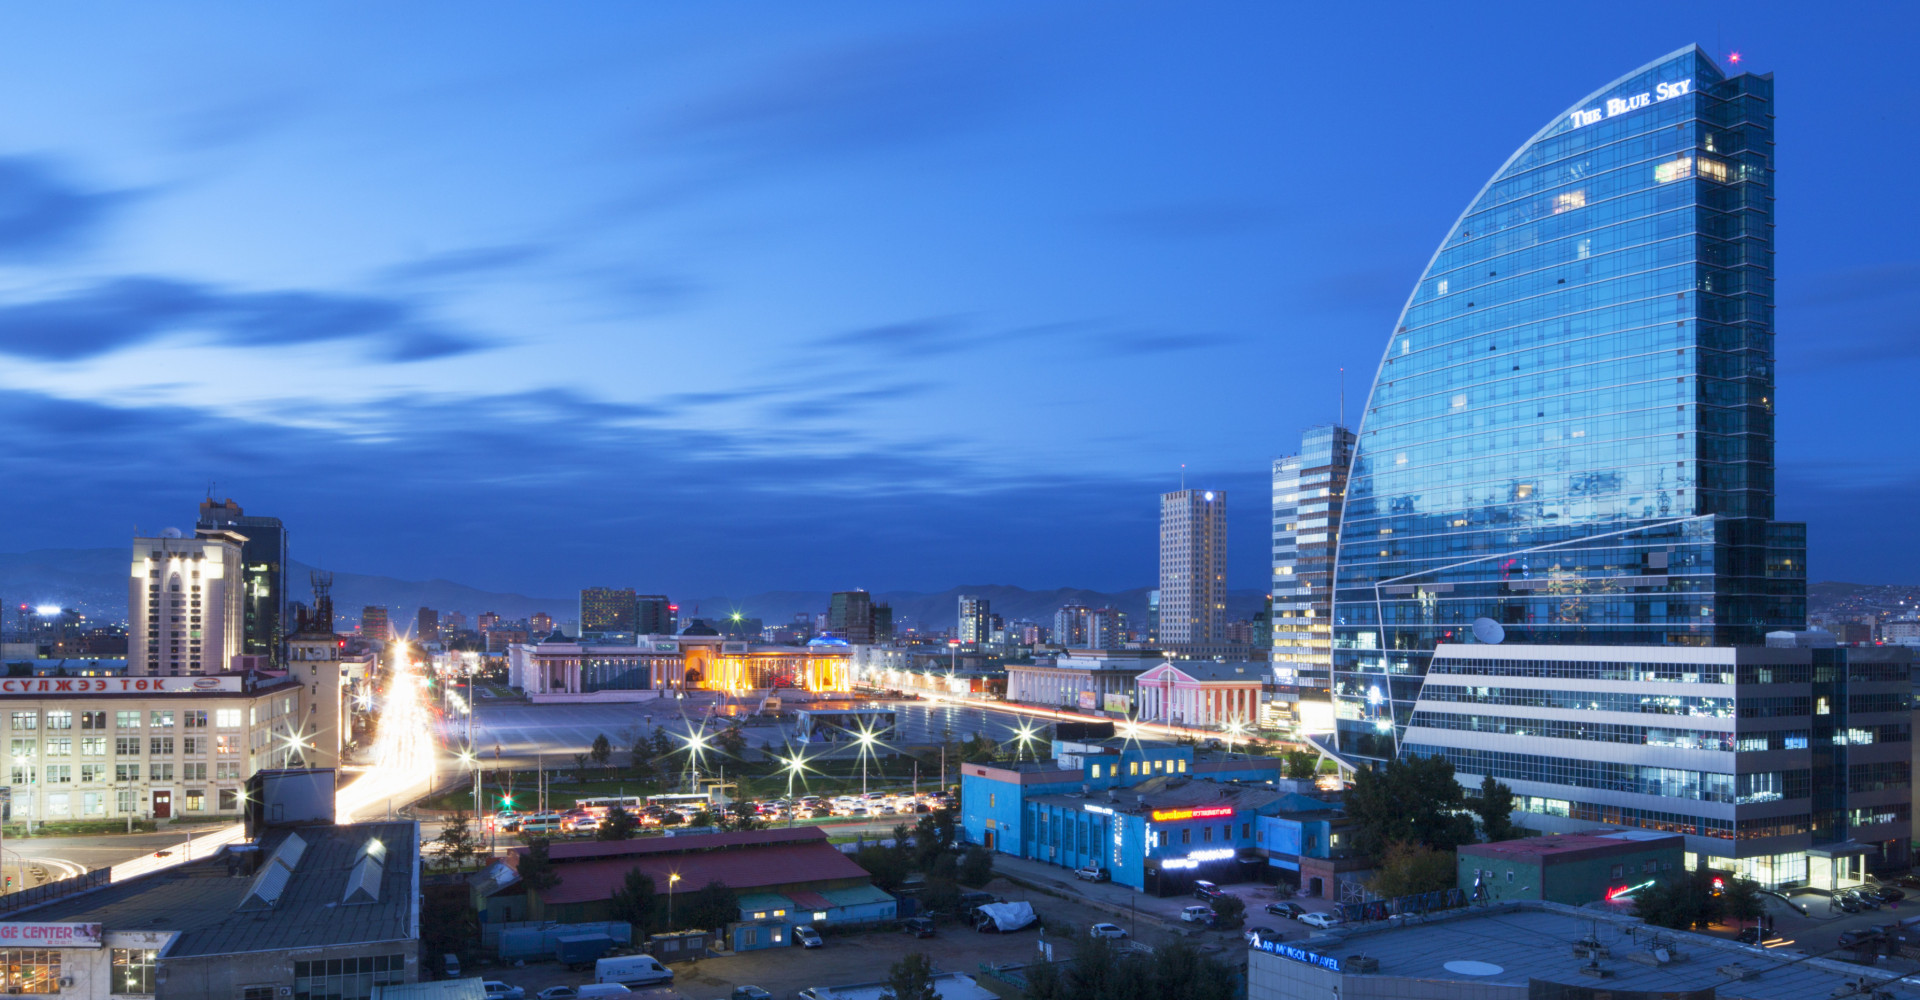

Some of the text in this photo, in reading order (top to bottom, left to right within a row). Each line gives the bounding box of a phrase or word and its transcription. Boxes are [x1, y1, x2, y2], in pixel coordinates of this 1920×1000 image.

[1570, 79, 1691, 128] THE BLUE SKY
[2, 679, 165, 692] СҮЛЖЭЭ ТӨК
[22, 926, 73, 939] CENTER
[1275, 943, 1308, 962] MNGOL
[1308, 952, 1340, 971] TRAVEL
